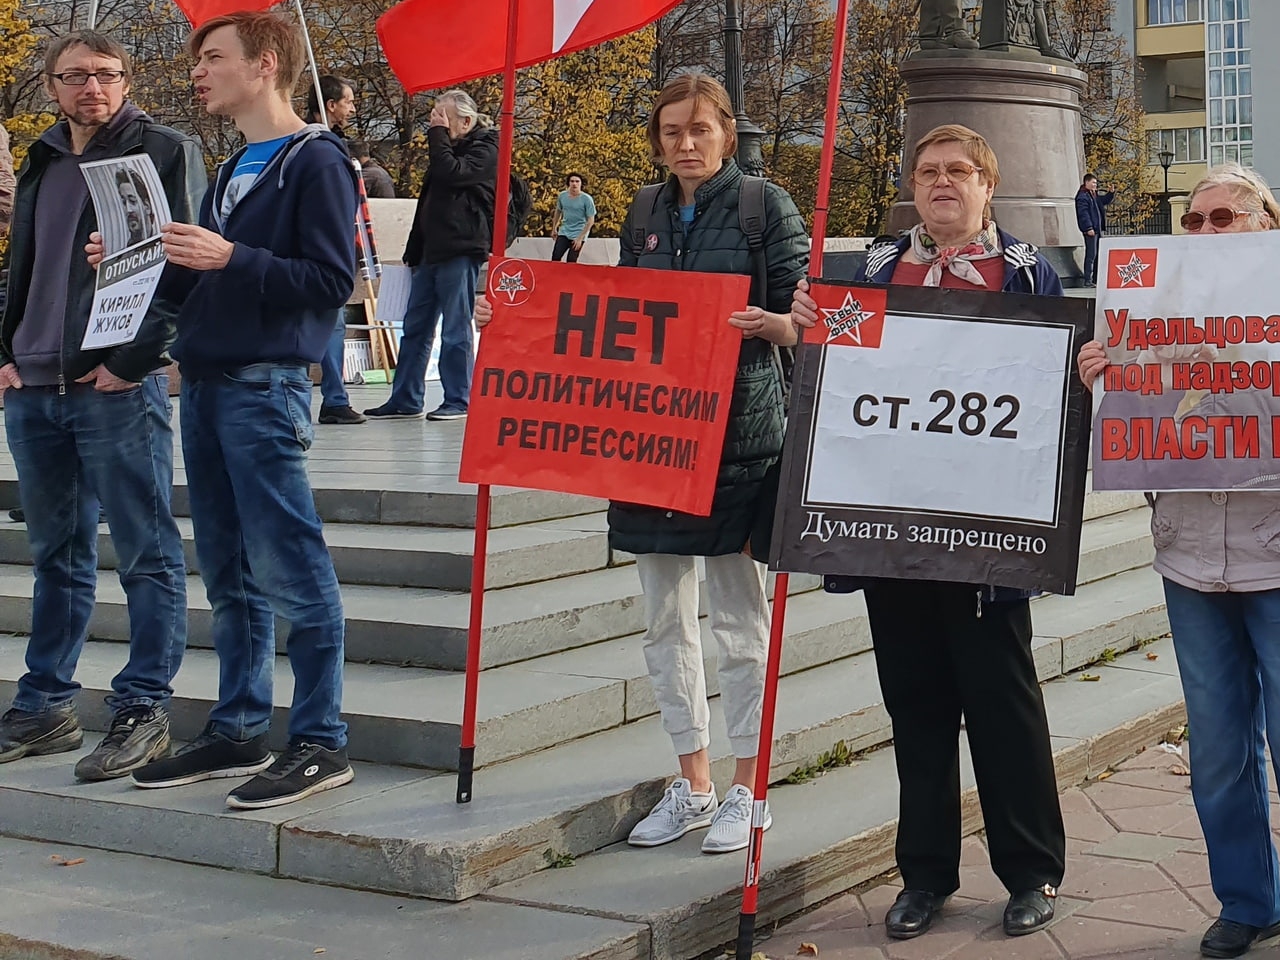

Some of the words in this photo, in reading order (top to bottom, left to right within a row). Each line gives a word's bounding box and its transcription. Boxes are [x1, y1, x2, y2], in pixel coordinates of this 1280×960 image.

[92, 313, 133, 334] ЖУКОВ
[98, 292, 146, 314] КИРИЛЛ
[831, 312, 865, 336] ФРОНТ
[553, 291, 679, 365] НЕТ
[480, 367, 720, 423] ПОЛИТИЧЕСКИМ
[1103, 361, 1163, 395] под
[852, 389, 1022, 440] ст.282
[496, 417, 700, 471] РЕПРЕССИЯМ!
[1101, 415, 1261, 462] ВЛАСТИ
[800, 511, 899, 541] Думать
[907, 524, 1047, 555] запрещено
